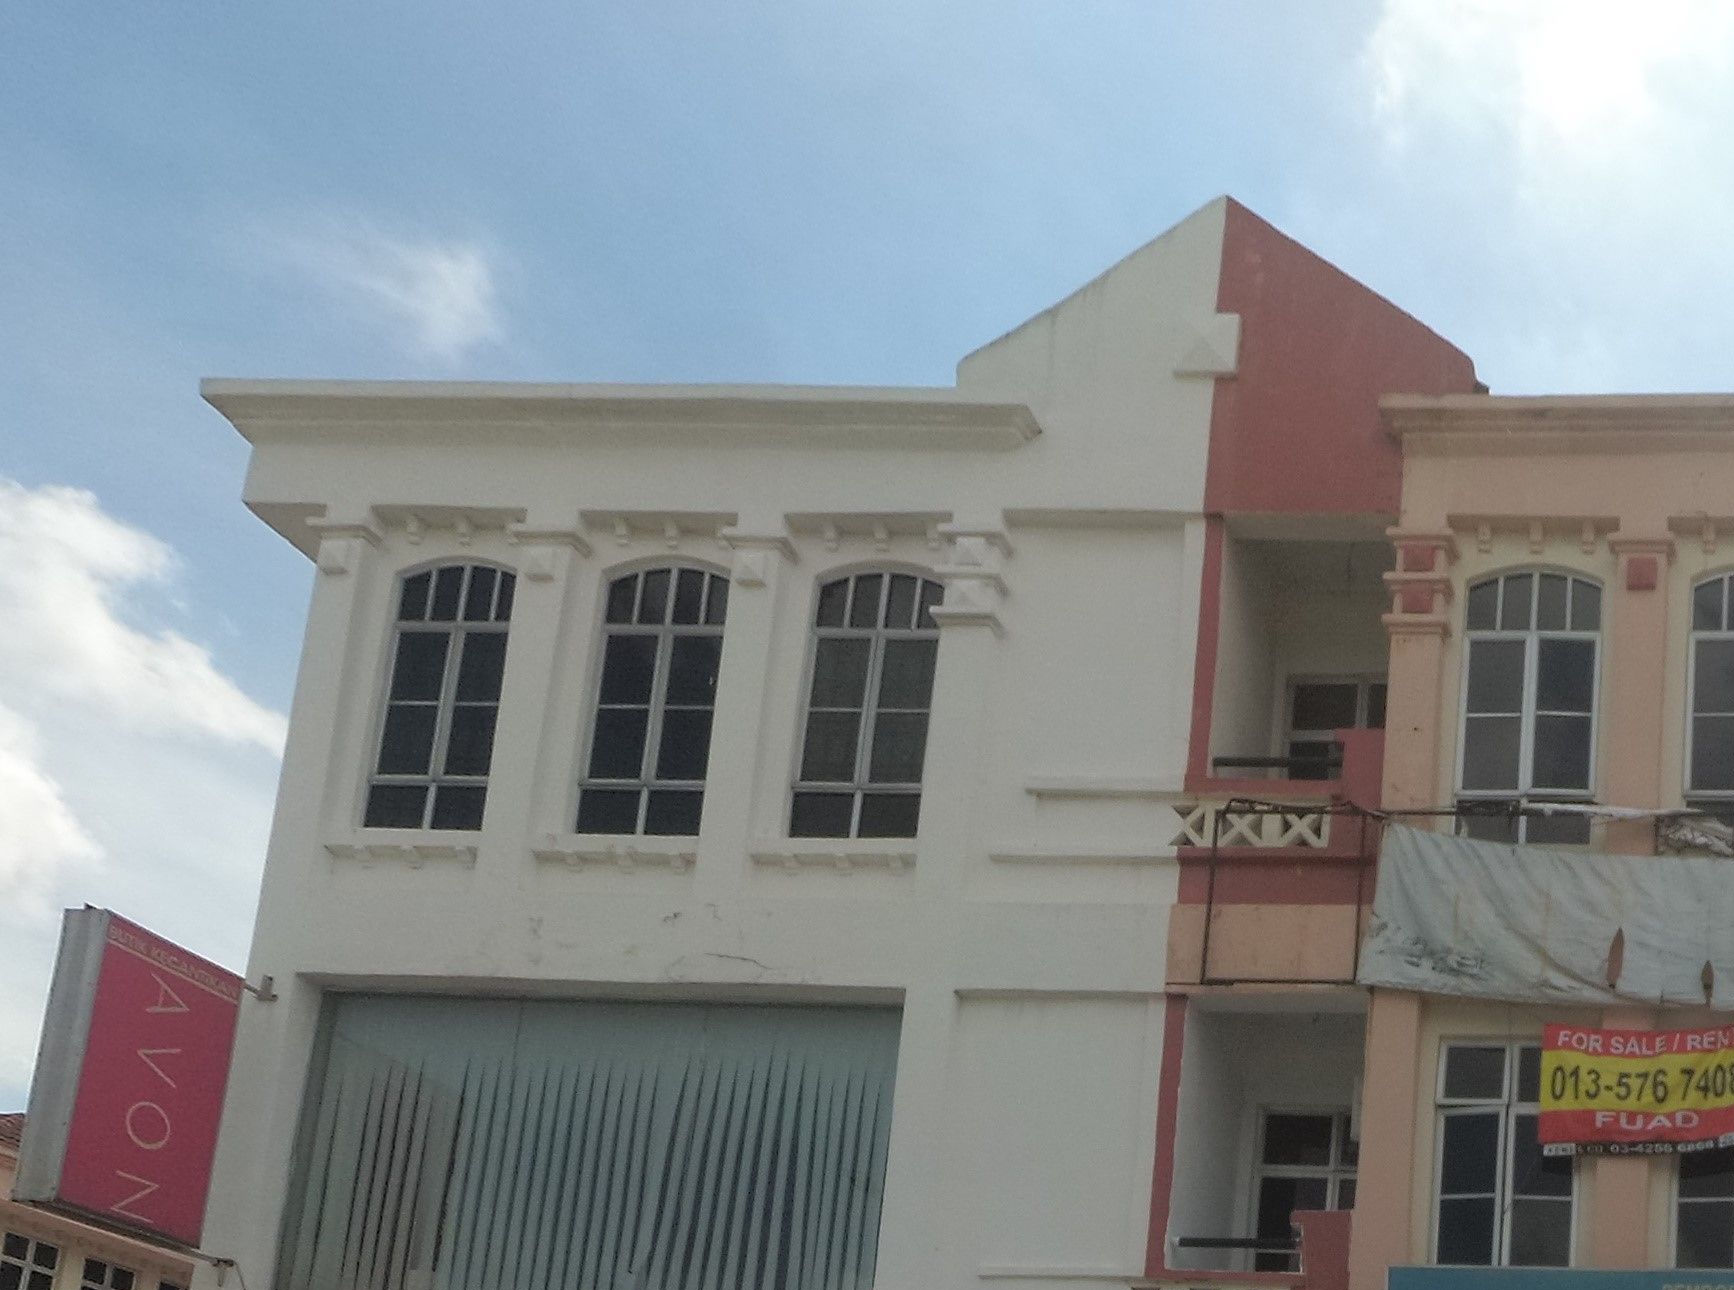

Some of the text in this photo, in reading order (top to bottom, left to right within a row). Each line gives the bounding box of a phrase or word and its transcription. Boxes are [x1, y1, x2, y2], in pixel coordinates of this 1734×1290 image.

[1557, 1031, 1603, 1053] FOR
[1610, 1034, 1667, 1056] SALE
[111, 973, 190, 1224] AVON
[1550, 1064, 1669, 1104] 013-576
[1595, 1110, 1700, 1131] FUAD
